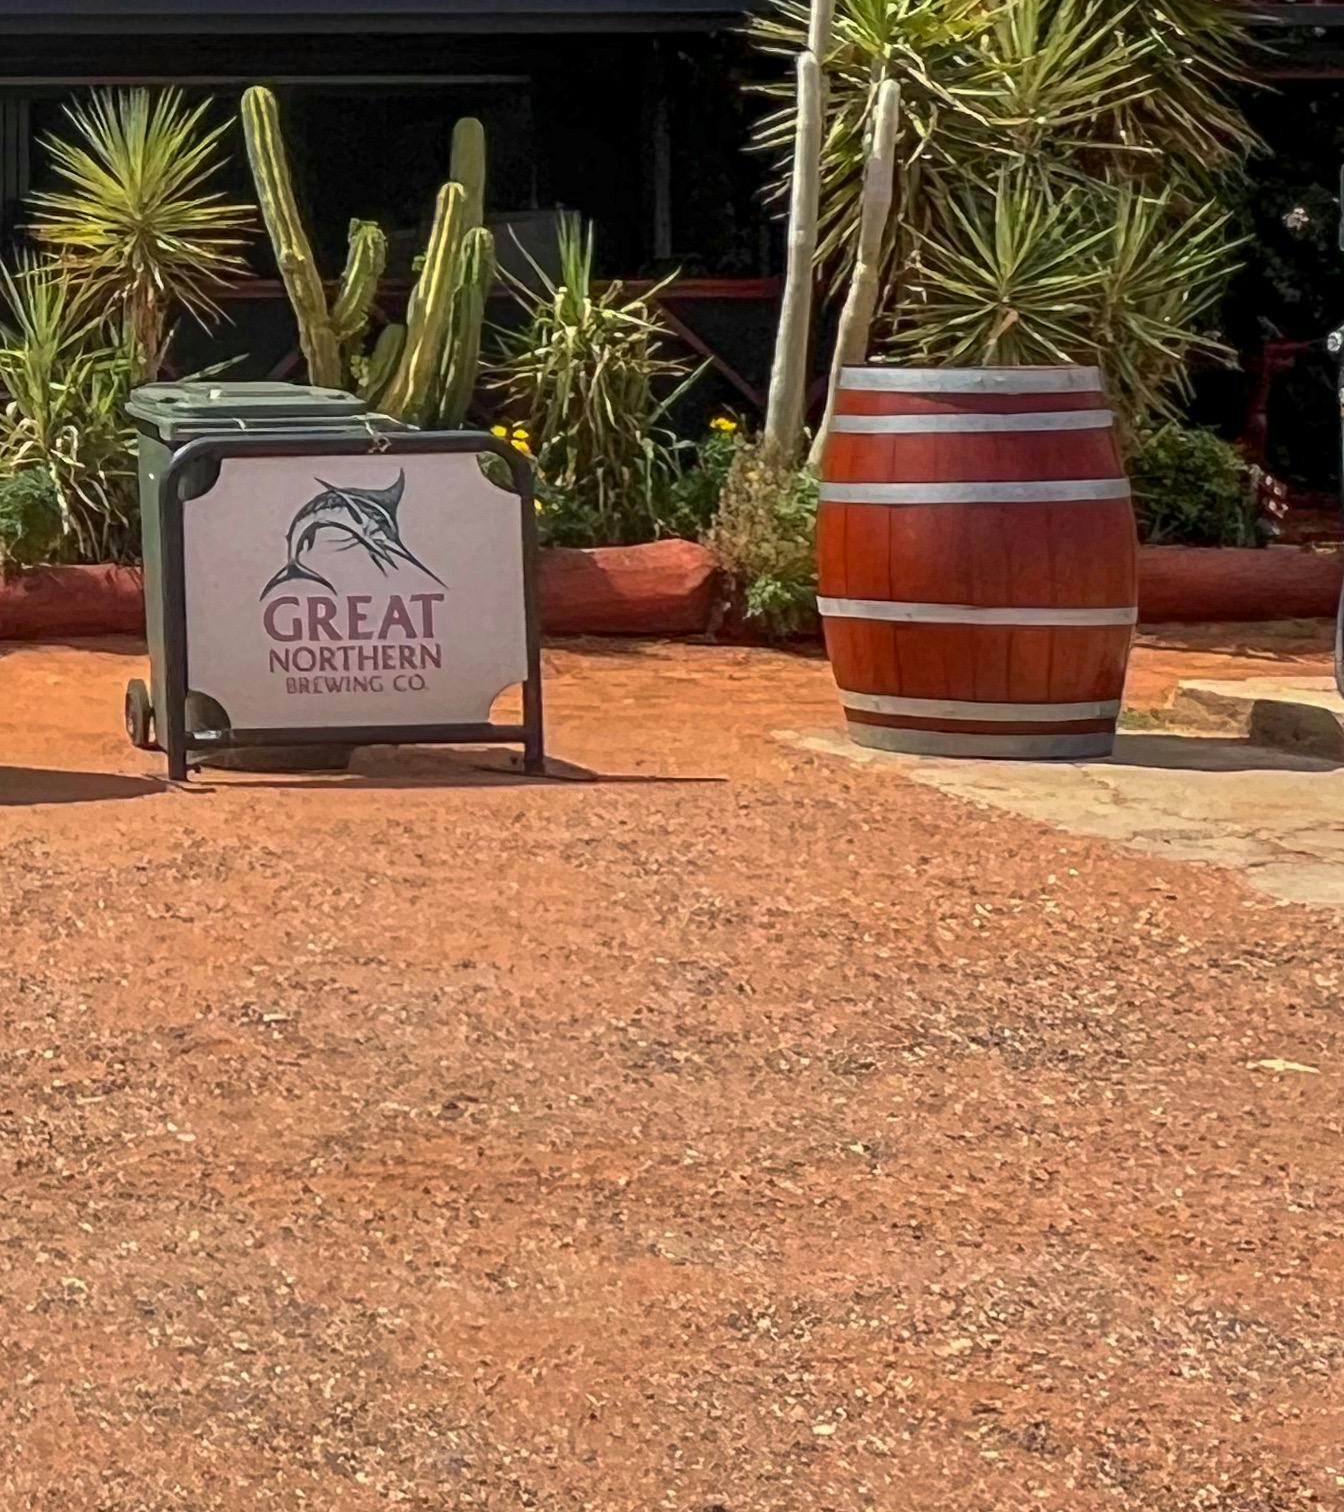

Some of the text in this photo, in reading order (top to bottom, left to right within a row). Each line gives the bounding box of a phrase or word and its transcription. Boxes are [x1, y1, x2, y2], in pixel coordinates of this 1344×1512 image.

[263, 593, 445, 642] GREAT
[268, 643, 442, 674] NORTHERN
[285, 674, 384, 695] BREWING
